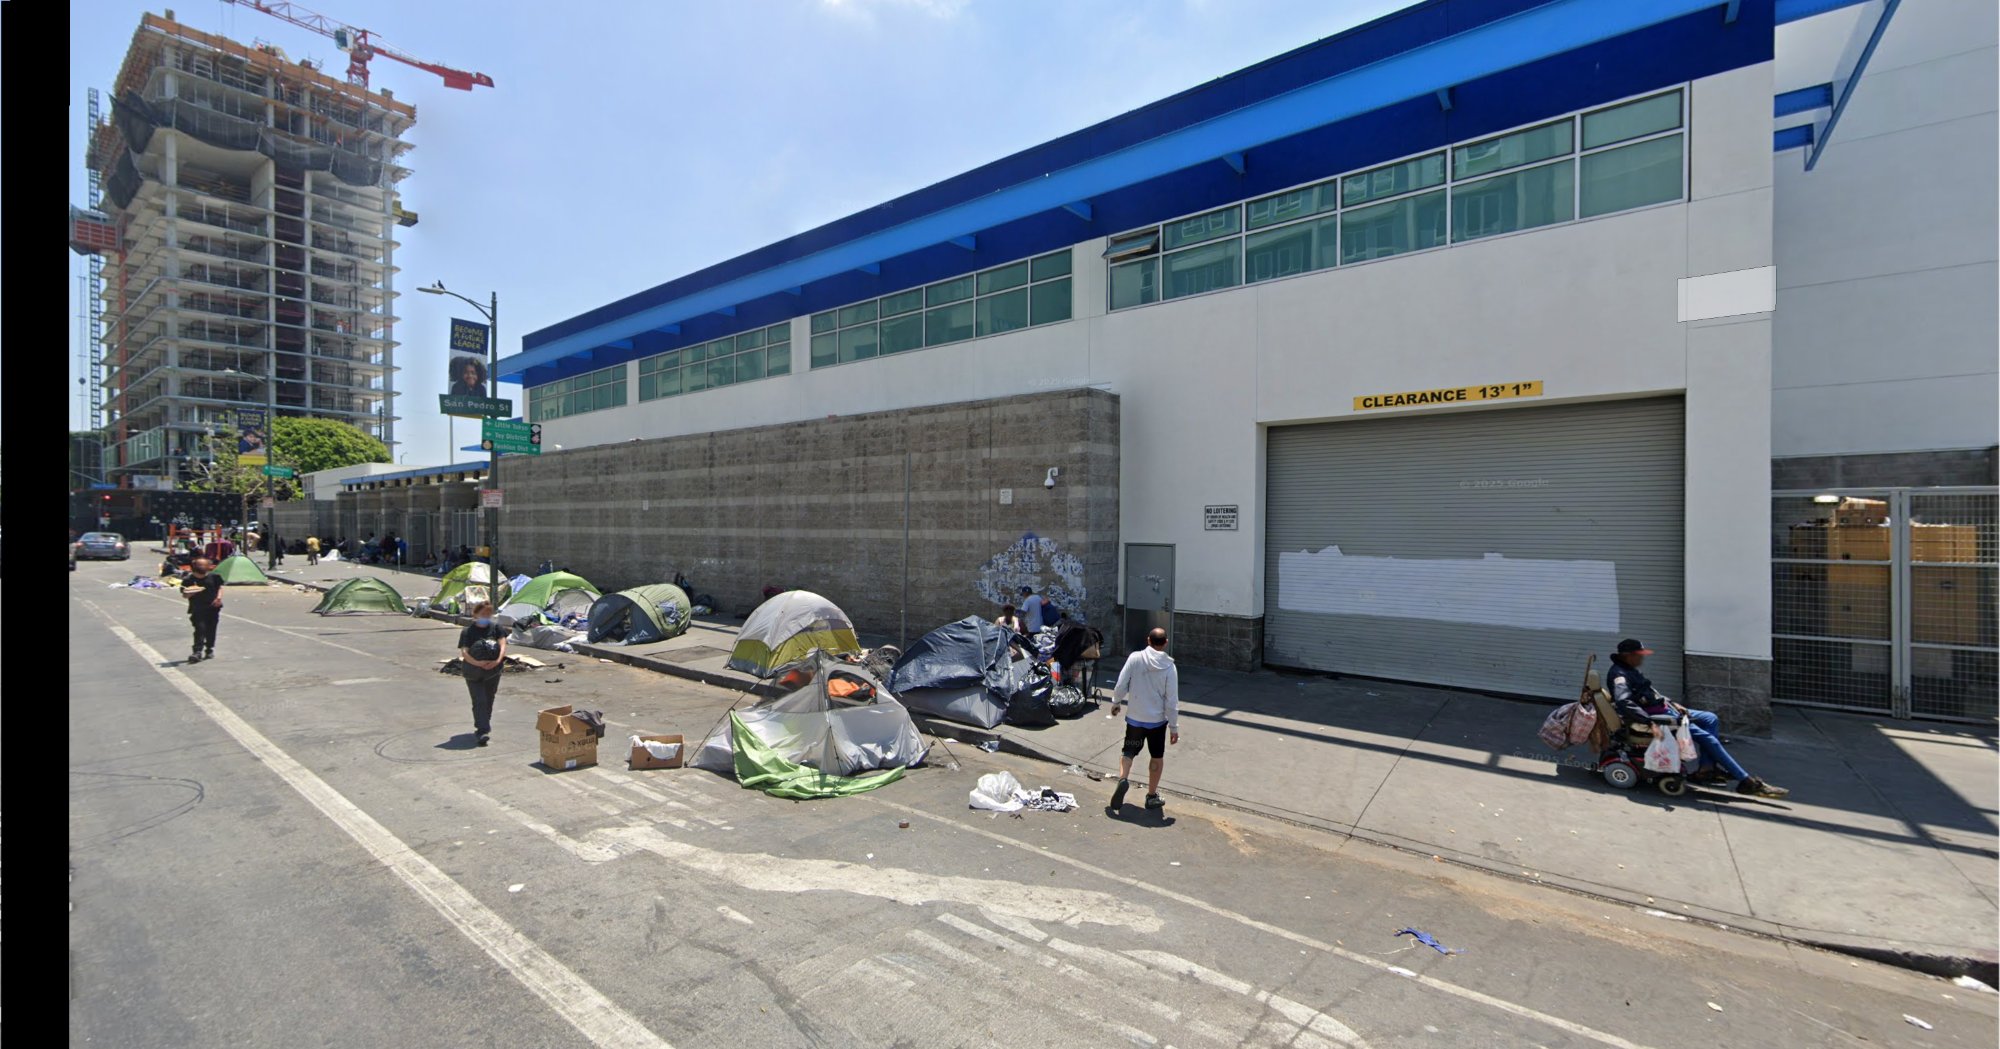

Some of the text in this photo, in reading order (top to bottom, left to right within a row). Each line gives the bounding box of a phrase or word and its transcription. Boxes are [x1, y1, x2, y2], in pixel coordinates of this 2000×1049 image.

[454, 339, 481, 350] LEADER
[1362, 388, 1467, 408] CLEARANCE
[1479, 385, 1506, 399] 13'
[444, 399, 509, 412] San Pedro St
[494, 421, 510, 429] Little
[495, 432, 528, 441] Toy District
